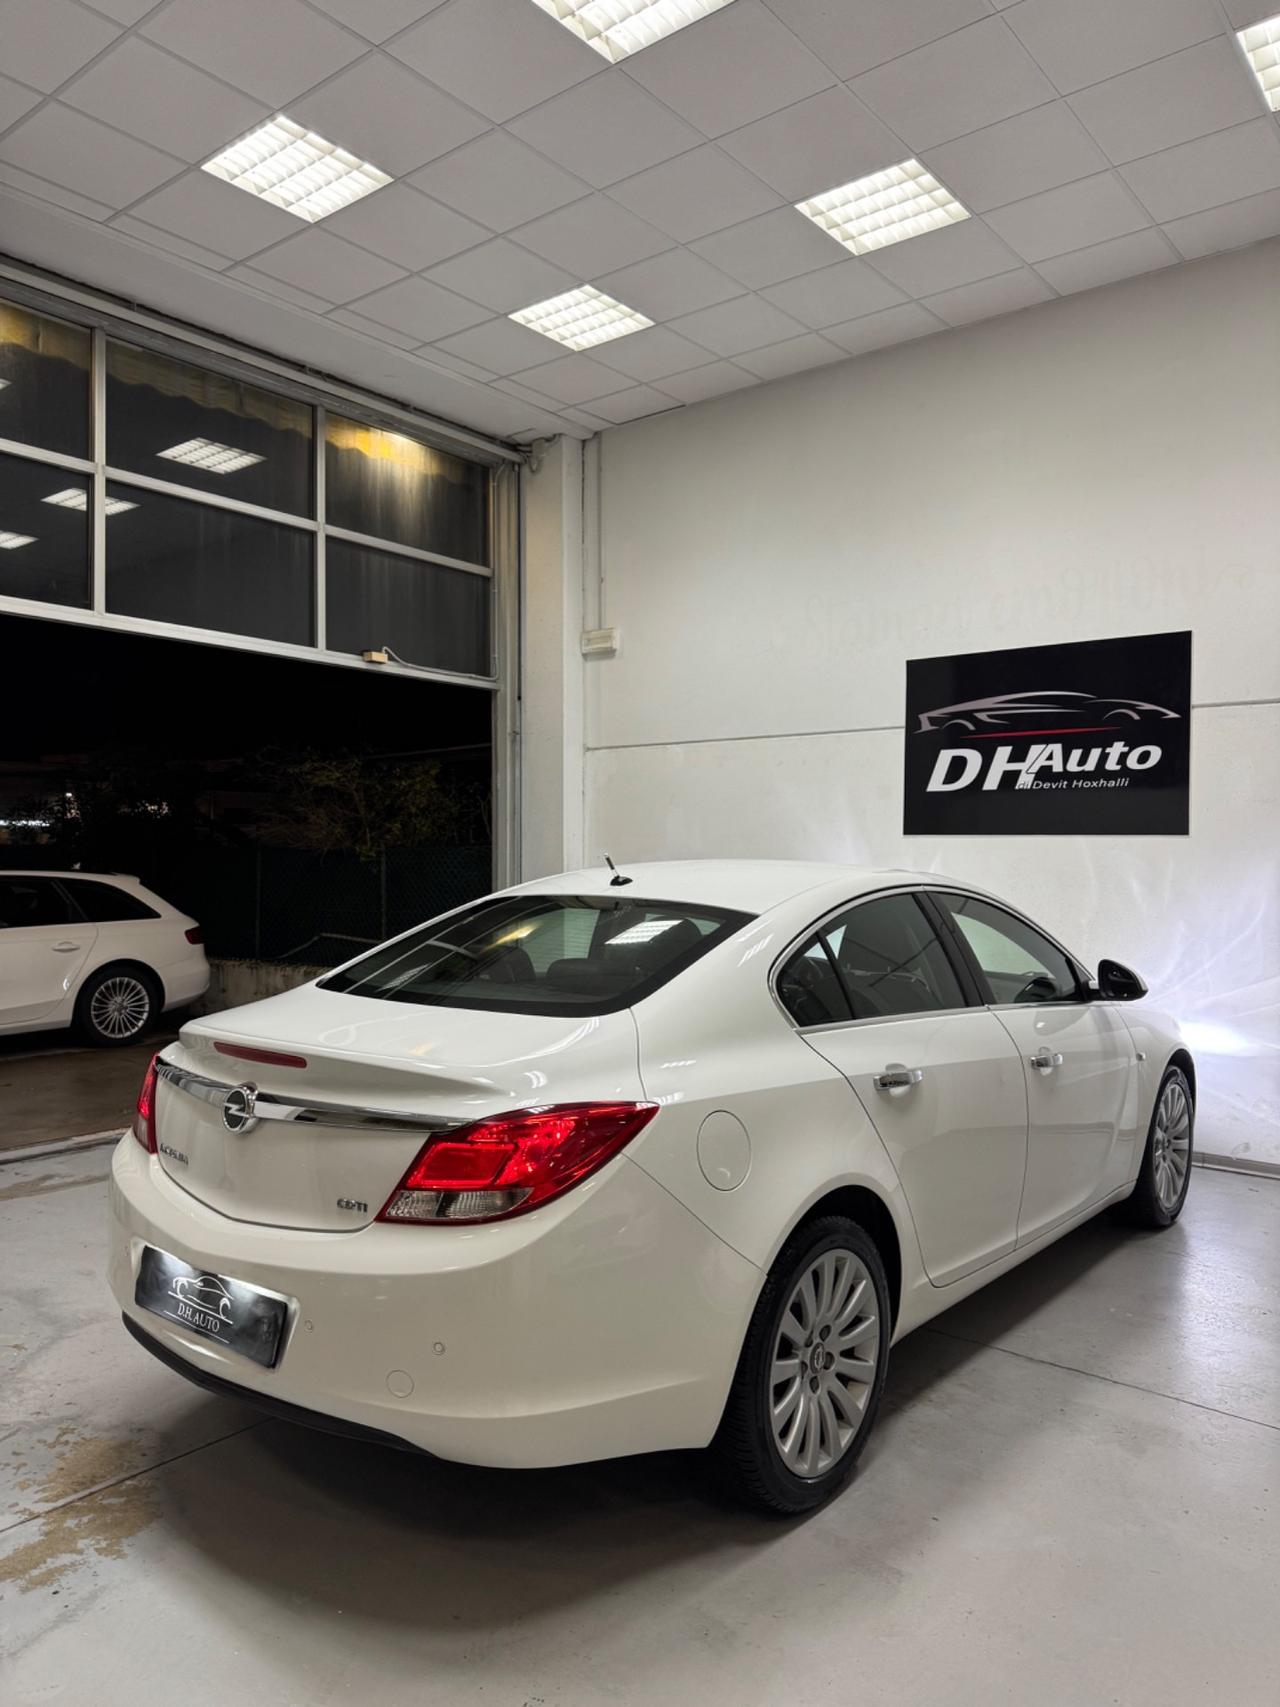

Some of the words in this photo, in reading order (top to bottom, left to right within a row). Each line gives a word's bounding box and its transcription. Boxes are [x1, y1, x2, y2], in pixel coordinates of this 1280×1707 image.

[1032, 780, 1068, 789] Devit
[1072, 777, 1130, 788] Hoxhalli
[193, 1312, 220, 1332] AUTO
